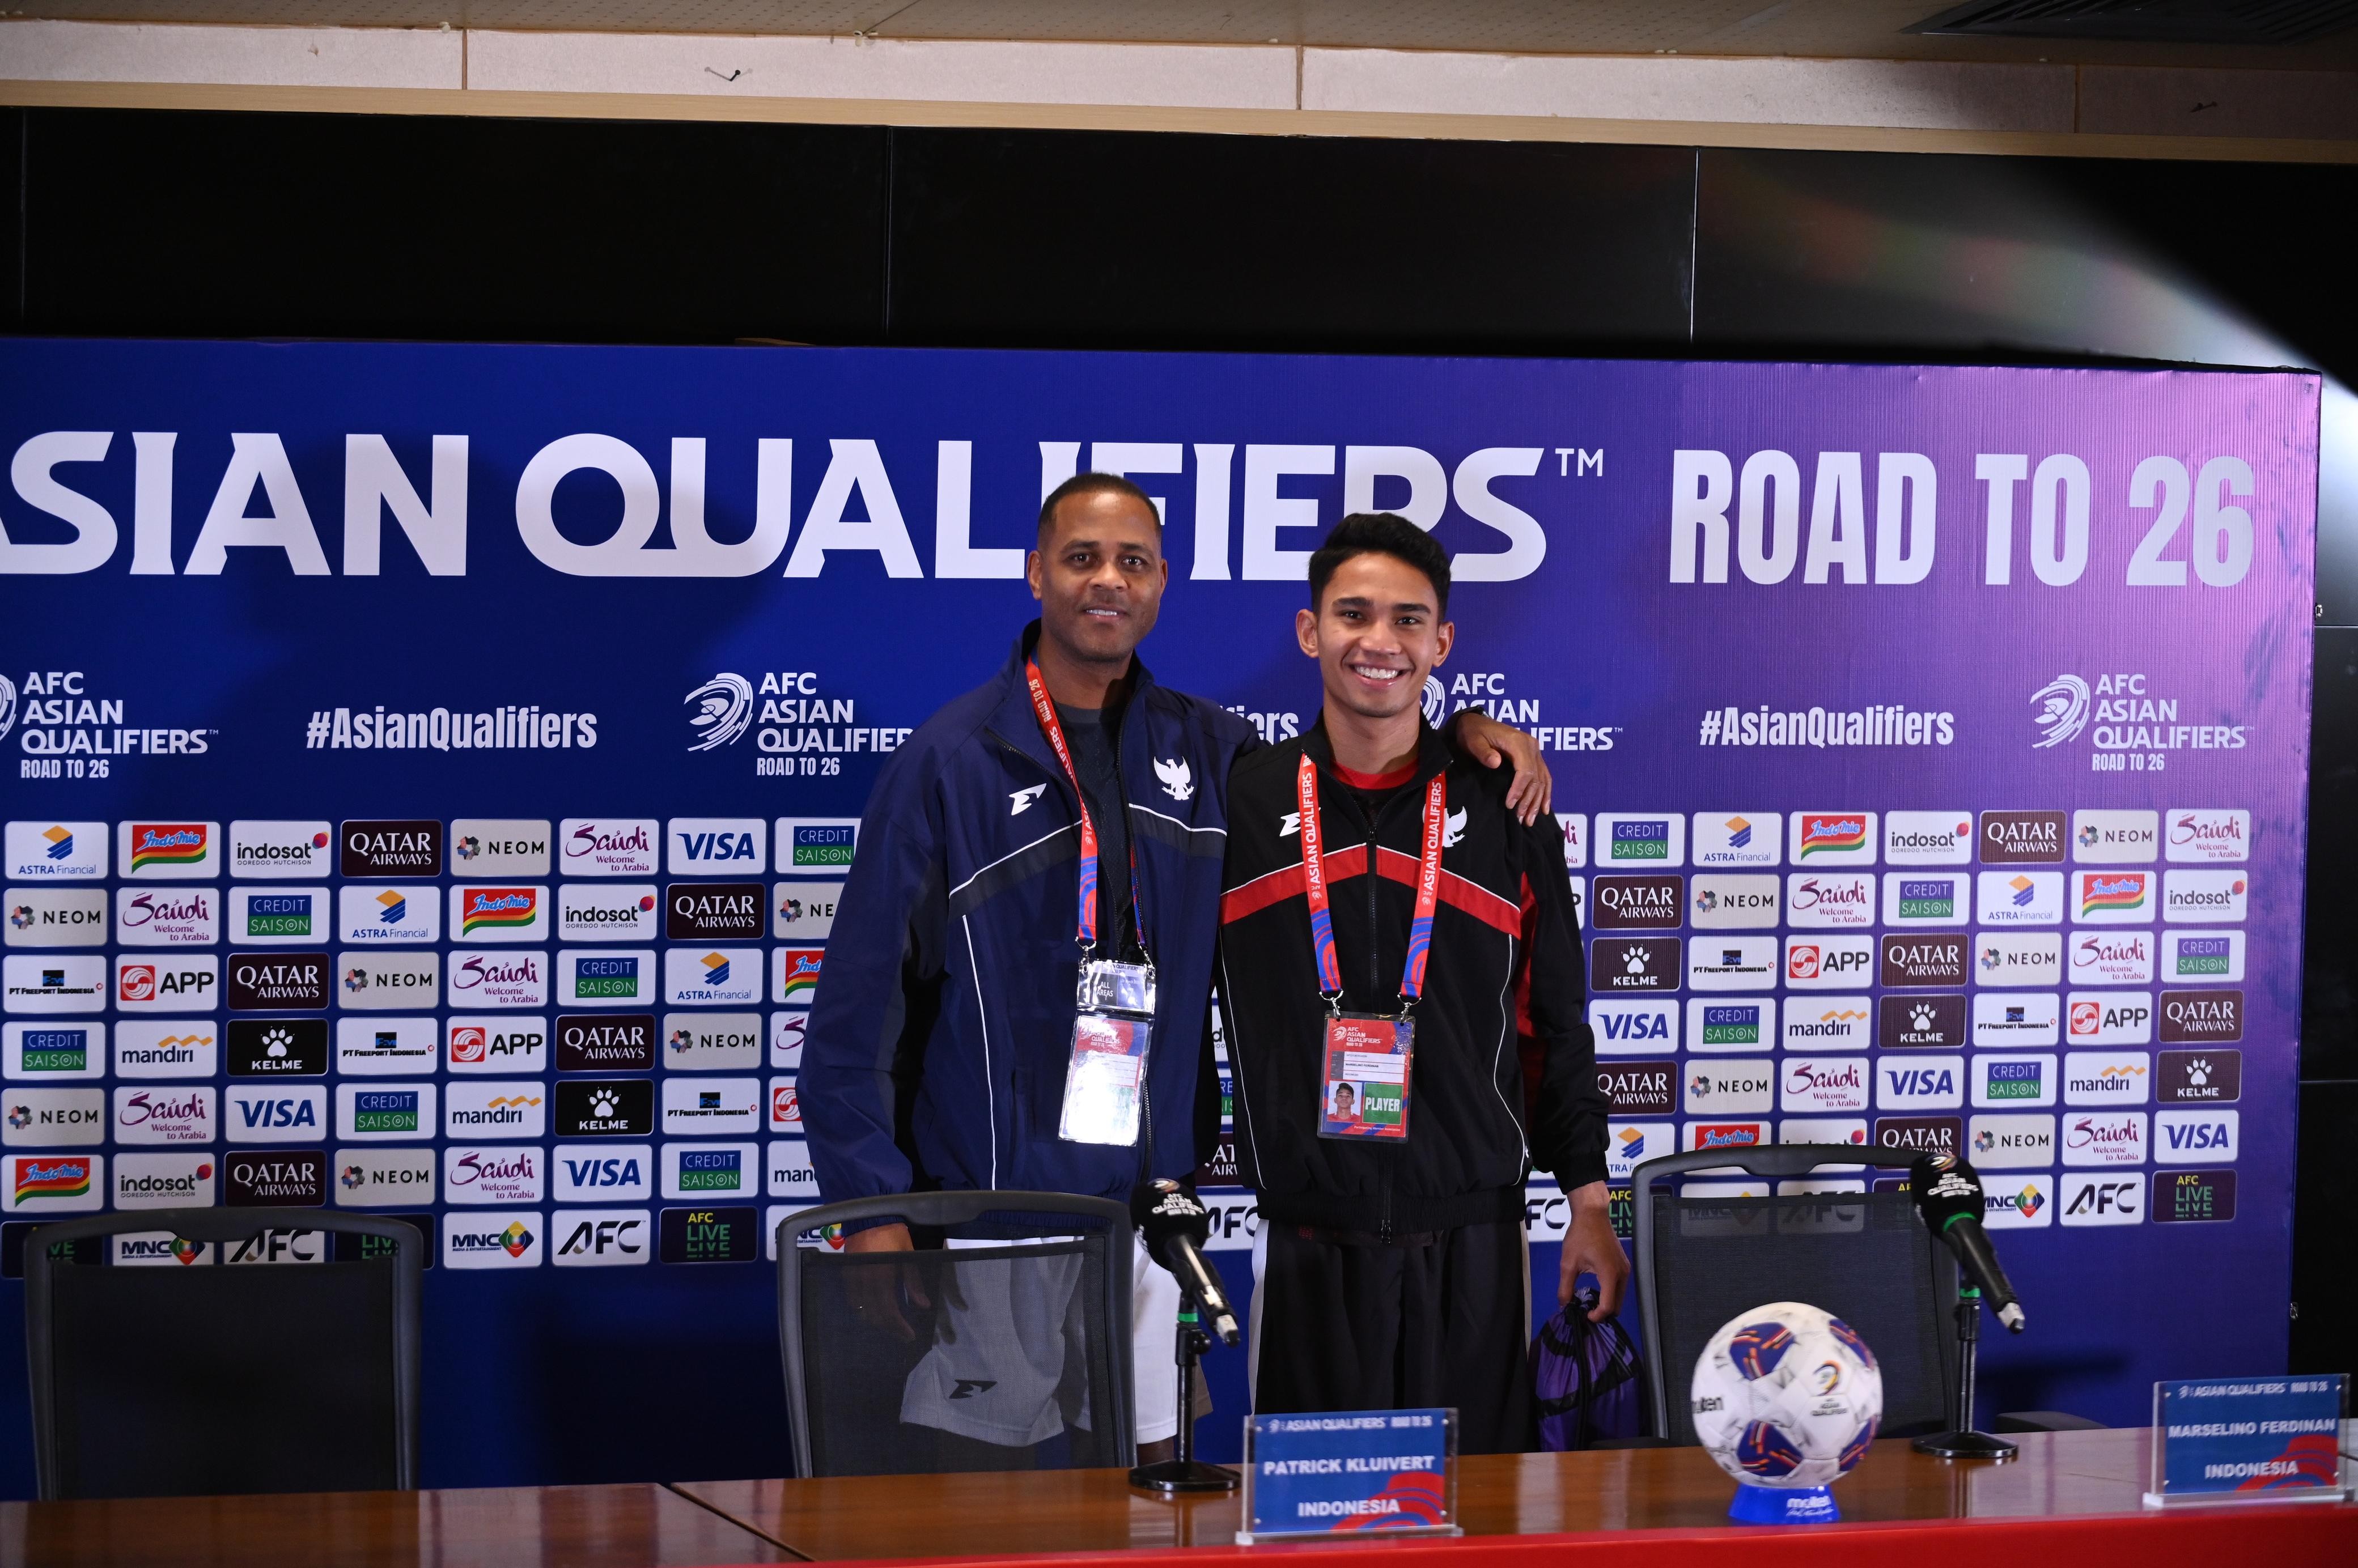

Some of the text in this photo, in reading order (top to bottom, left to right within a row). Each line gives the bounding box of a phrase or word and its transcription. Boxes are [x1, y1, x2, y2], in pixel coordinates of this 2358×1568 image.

[0, 431, 469, 576] SIAN
[1670, 449, 1937, 584] ROAD
[1975, 453, 2090, 586] TO
[2126, 455, 2254, 587] 26
[22, 672, 84, 695] AFC
[759, 672, 817, 695] AFC
[1029, 678, 1041, 690] 26
[1451, 673, 1504, 695] AFC
[2094, 674, 2145, 695] AFC
[1033, 690, 1044, 702] TO
[22, 700, 123, 725] ASIAN
[758, 699, 854, 723] ASIAN
[1037, 700, 1053, 723] ROAD
[2094, 699, 2177, 722] ASIAN
[307, 706, 597, 752] #AsianQualifiers
[1700, 705, 1954, 749] #AsianQualifiers
[21, 760, 109, 778] ROAD TO 26
[757, 757, 840, 776] ROAD TO 26
[2092, 753, 2165, 771] ROAD TO 26
[1302, 772, 1317, 842] QUALIFIERS
[800, 830, 848, 842] CREDIT
[1423, 781, 1442, 891] ASIAN QUALIFIERS
[1618, 825, 1663, 836] CREDIT
[1988, 822, 2056, 847] QATAR
[2106, 830, 2152, 842] NEOM
[238, 843, 311, 859] indosat
[350, 833, 431, 859] QATAR
[489, 842, 544, 854] NEOM
[677, 833, 755, 860] VISA
[1614, 843, 1665, 855] SAISON
[2005, 842, 2056, 852] AIRWAYS
[371, 853, 431, 864] AIRWAYS
[797, 849, 851, 861] SAISON
[1737, 852, 1770, 861] Financial
[57, 865, 96, 874] Financial
[1307, 844, 1320, 883] ASIAN
[2170, 890, 2230, 905] indosat
[255, 900, 305, 912] CREDIT
[676, 896, 754, 921] QATAR
[810, 904, 834, 917] NE
[44, 911, 100, 924] NEOM
[251, 919, 308, 931] SAISON
[695, 916, 754, 927] AIRWAYS
[1823, 952, 1869, 971] APP
[160, 972, 214, 993] APP
[377, 974, 432, 987] NEOM
[1614, 976, 1657, 985] KELME
[2167, 1001, 2233, 1026] QATAR
[1597, 1014, 1668, 1039] VISA
[1789, 1020, 1850, 1036] mandiri
[2183, 1021, 2234, 1031] AIRWAYS
[28, 1035, 80, 1047] CREDIT
[490, 1034, 542, 1055] APP
[26, 1054, 83, 1067] SAISON
[122, 1046, 193, 1063] mandiri
[252, 1060, 302, 1069] KELME
[1993, 1065, 2035, 1077] CREDIT
[1719, 1080, 1767, 1092] NEOM
[1990, 1083, 2038, 1095] SAISON
[2178, 1087, 2219, 1097] KELME
[1365, 1097, 1401, 1112] PLAYER
[235, 1100, 315, 1127] VISA
[453, 1106, 521, 1123] mandiri
[580, 1120, 628, 1129] KELME
[2163, 1124, 2228, 1149] VISA
[234, 1163, 315, 1189] QATAR
[374, 1170, 428, 1183] NEOM
[2177, 1175, 2198, 1185] AFC
[255, 1184, 315, 1195] AIRWAYS
[1610, 1191, 1631, 1200] AFC
[2176, 1187, 2212, 1201] LIVE
[2066, 1183, 2136, 1214] AFC
[688, 1213, 713, 1222] AFC
[1525, 1198, 1566, 1230] FC
[452, 1234, 503, 1247] MNC
[558, 1221, 641, 1255] AFC
[688, 1225, 730, 1240] LIVE
[122, 1241, 172, 1254] MNC
[230, 1230, 316, 1263] AFC
[2168, 1418, 2336, 1438] MARSELINO FERDINAN
[1264, 1455, 1436, 1476] PATRICK KLUIVERT
[2204, 1460, 2299, 1479] INDONESIA
[1297, 1498, 1401, 1517] INDONESIA
